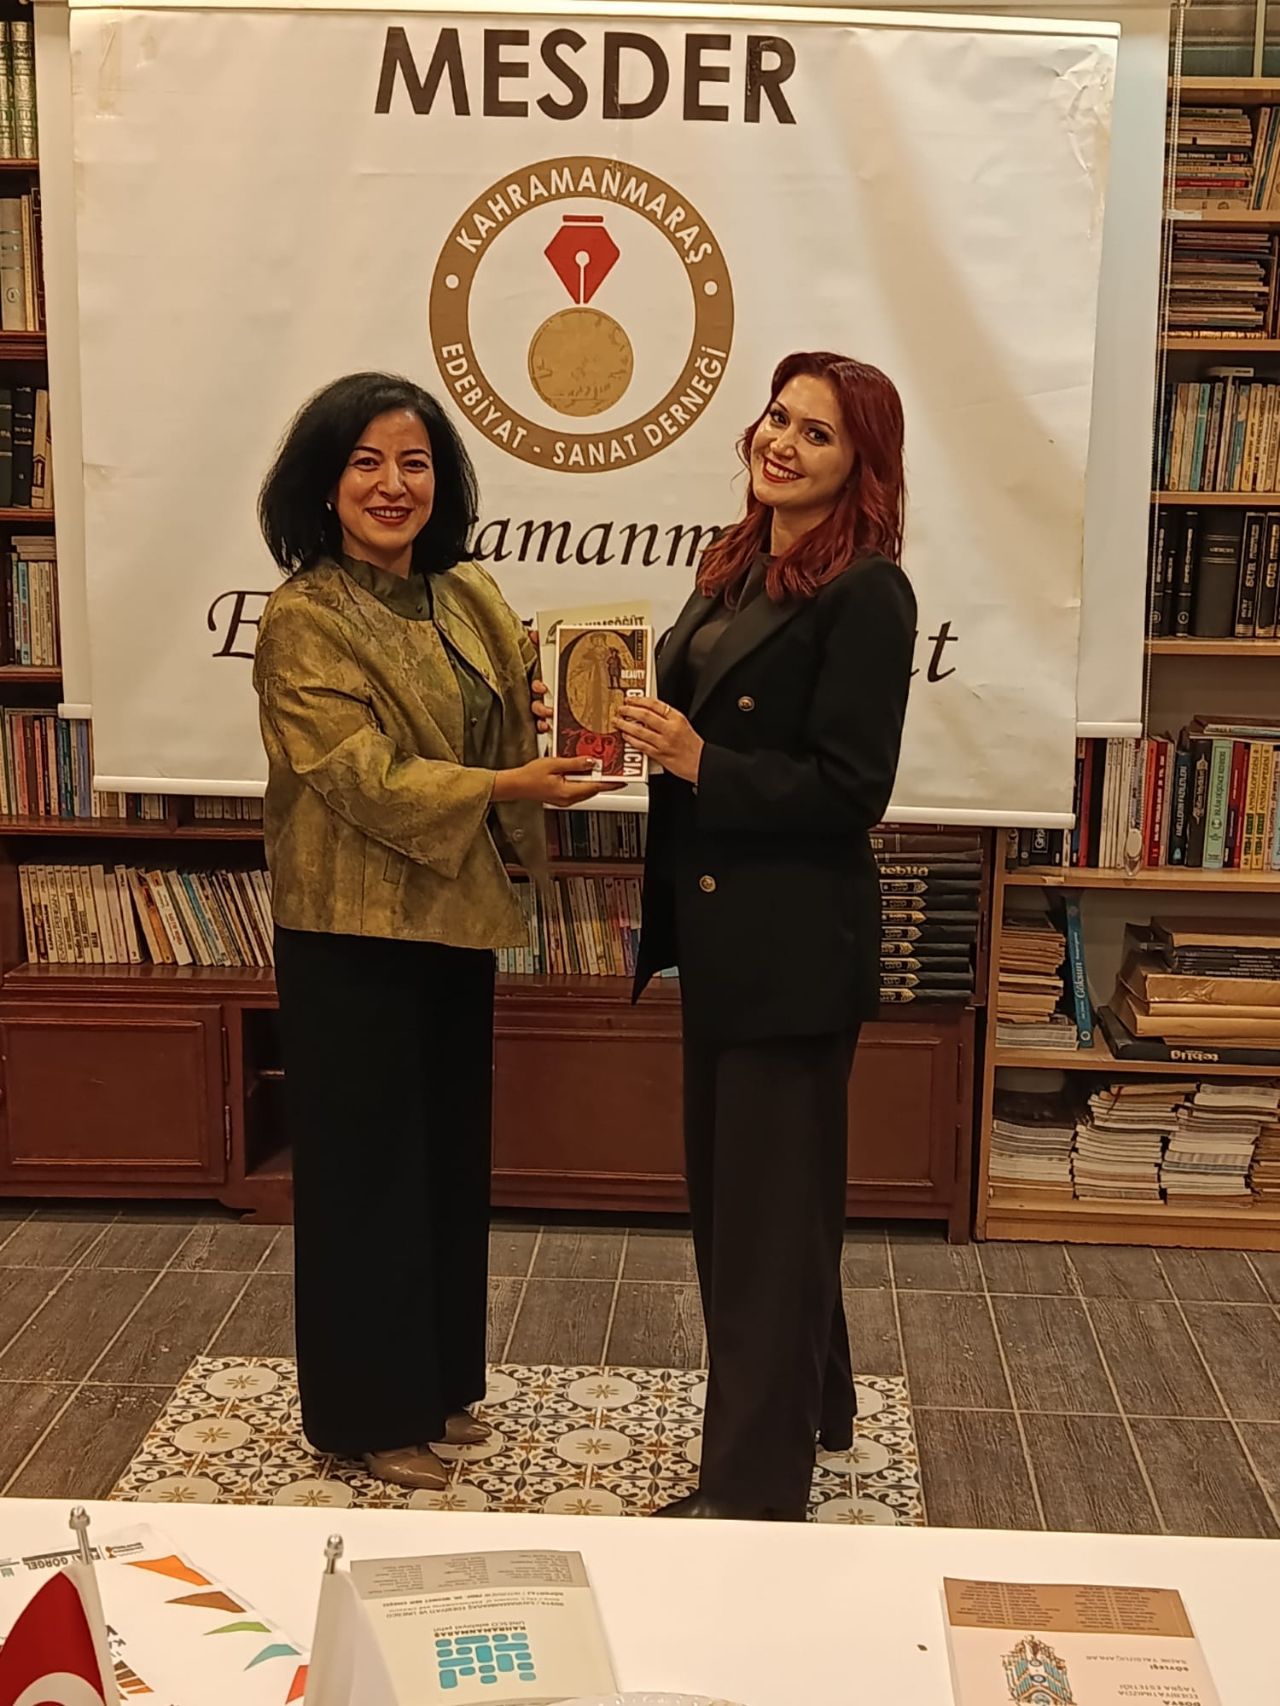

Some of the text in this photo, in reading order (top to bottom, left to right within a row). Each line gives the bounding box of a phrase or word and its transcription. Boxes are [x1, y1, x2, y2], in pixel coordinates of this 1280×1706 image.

[374, 26, 797, 125] MESDER
[455, 166, 713, 266] KAHRAMANMARAŞ
[441, 343, 527, 450] EDEBİYAT
[553, 438, 637, 467] SANAT
[646, 347, 728, 446] DERNEĞİ
[472, 517, 722, 568] amanm
[621, 669, 645, 680] BEAUTY
[24, 1556, 68, 1570] GÖRGEL
